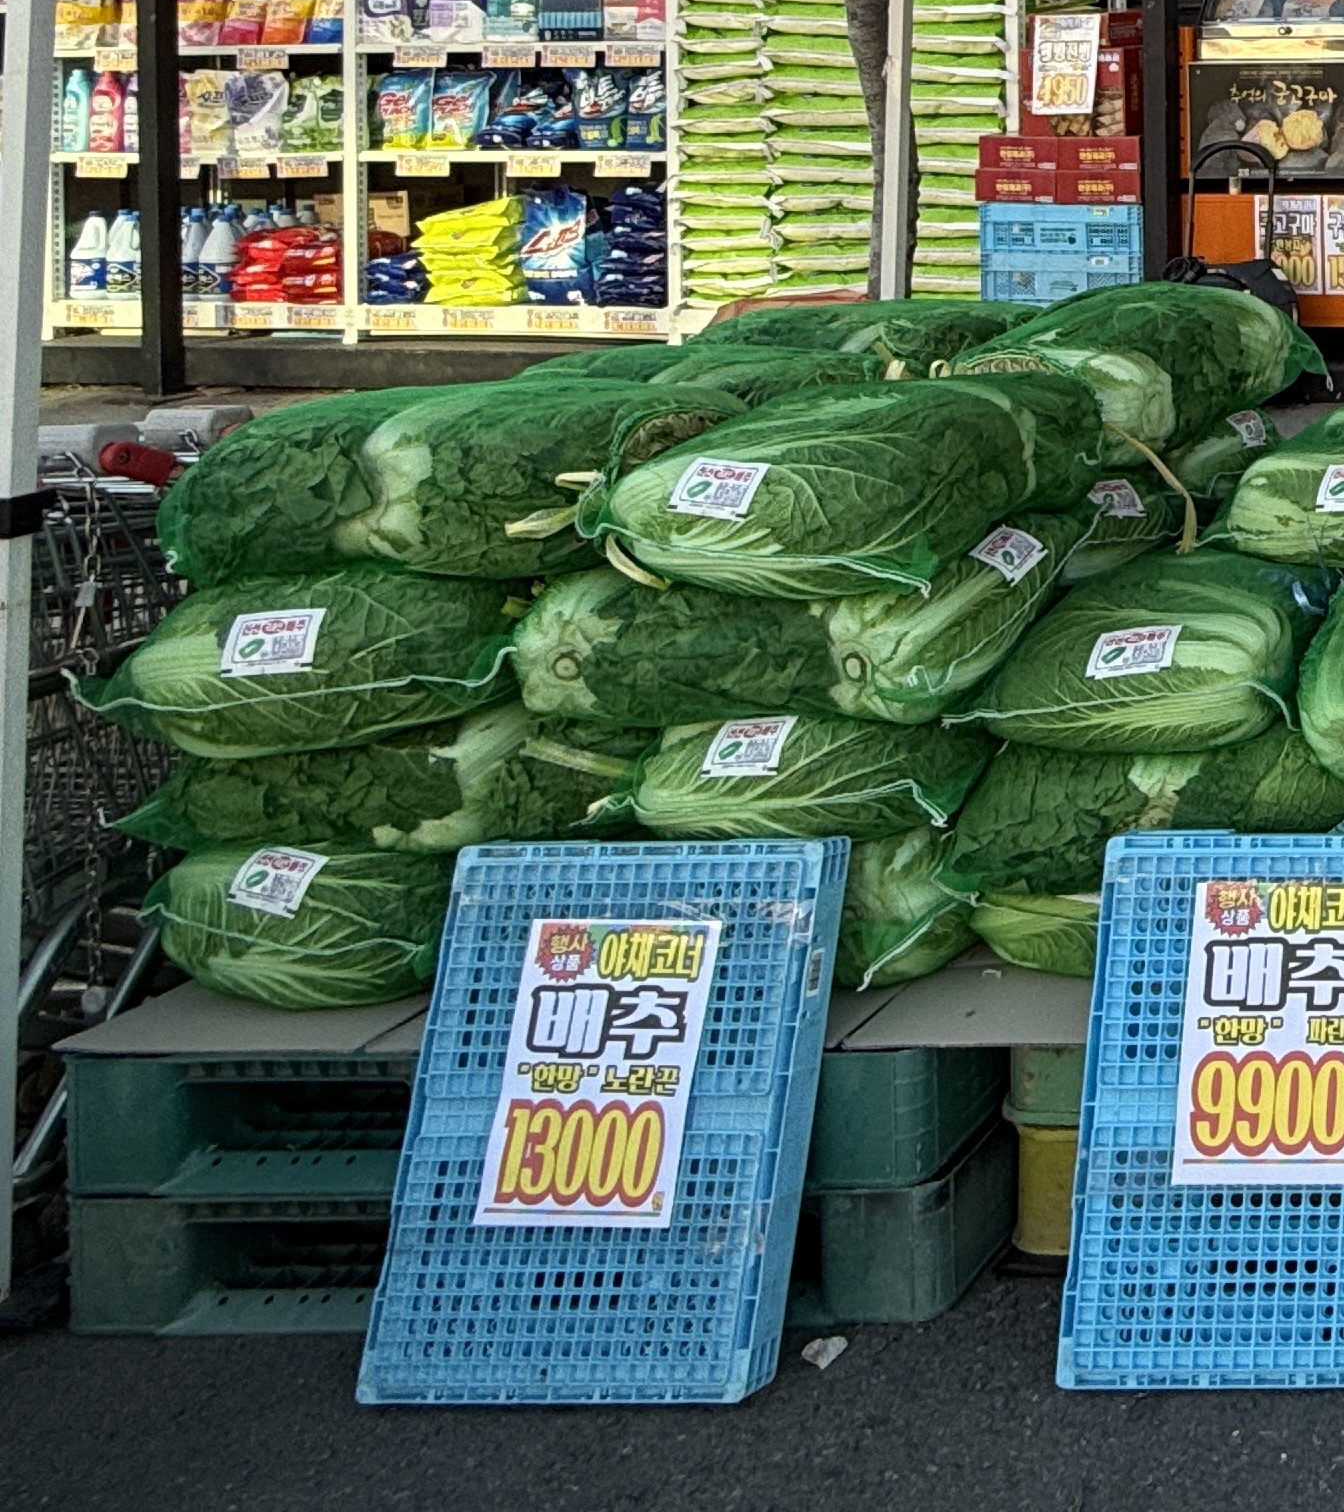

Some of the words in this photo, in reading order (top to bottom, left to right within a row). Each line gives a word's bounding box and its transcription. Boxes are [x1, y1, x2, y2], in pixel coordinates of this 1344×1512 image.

[1037, 73, 1088, 106] 4950
[1229, 83, 1266, 103] 추억의
[1218, 887, 1258, 910] 행사
[1220, 910, 1251, 926] 상품
[550, 934, 589, 953] 행사
[599, 931, 704, 980] 야채코너
[550, 953, 581, 972] 상품
[527, 983, 688, 1059] 배추
[600, 1065, 681, 1097] 노란끈
[494, 1099, 665, 1208] 13000
